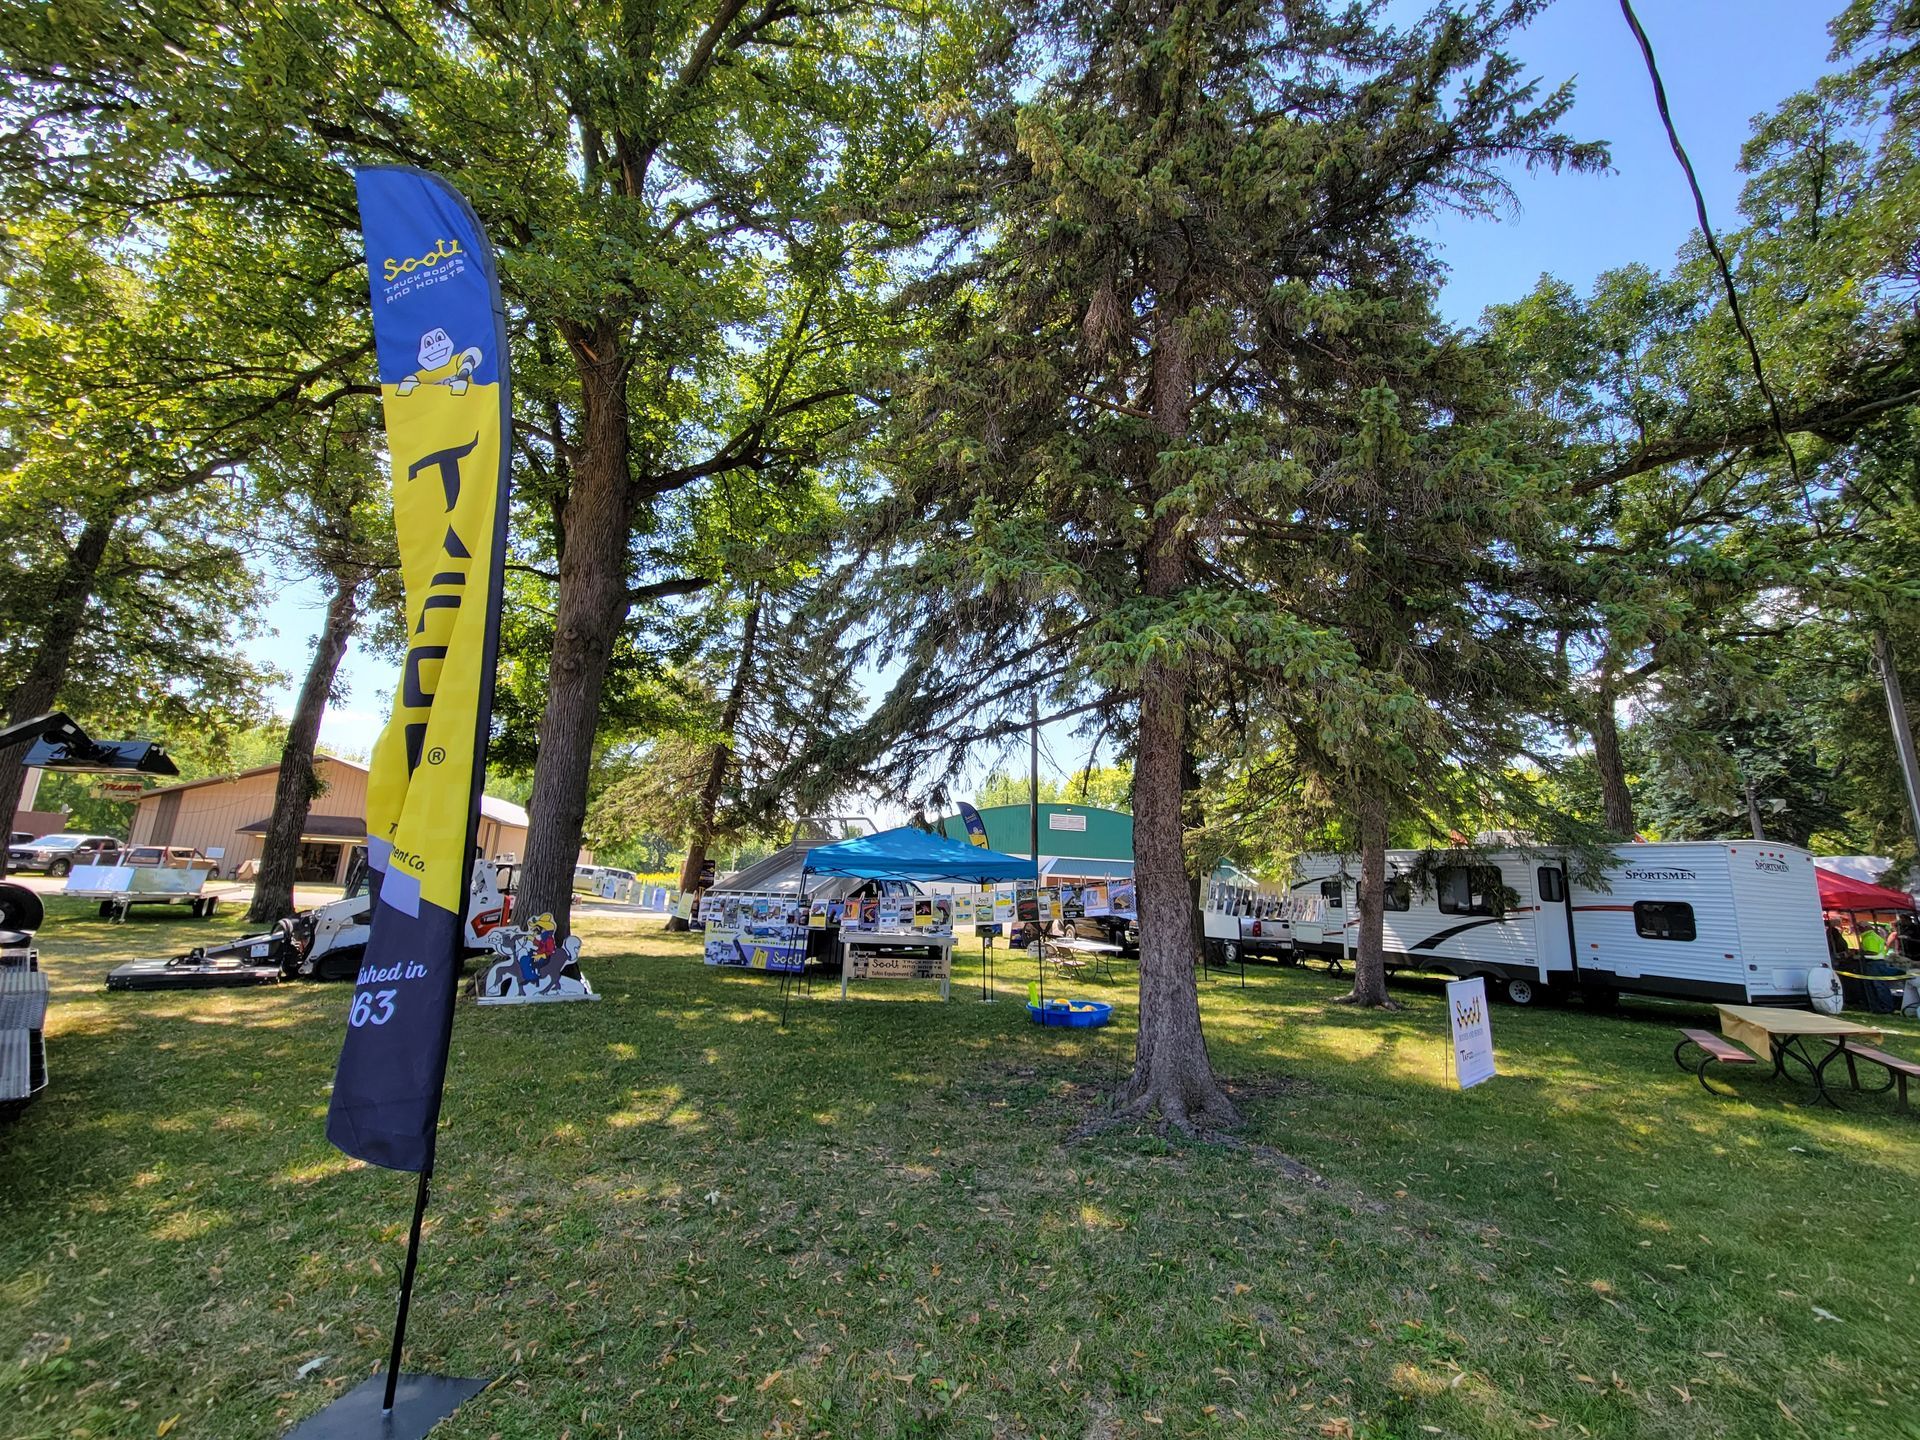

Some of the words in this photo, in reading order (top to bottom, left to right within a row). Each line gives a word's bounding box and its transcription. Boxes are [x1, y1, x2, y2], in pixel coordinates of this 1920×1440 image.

[384, 239, 462, 281] Scott
[384, 274, 420, 294] TRUCK
[423, 259, 463, 278] BODIES
[386, 287, 410, 304] AND
[416, 265, 464, 289] HOISTS
[408, 855, 426, 872] Co.
[1755, 860, 1789, 872] SPORTSMEN
[1625, 869, 1696, 880] SPORTSMEN
[405, 960, 428, 979] in
[872, 959, 898, 968] Scott
[349, 988, 397, 1028] 63
